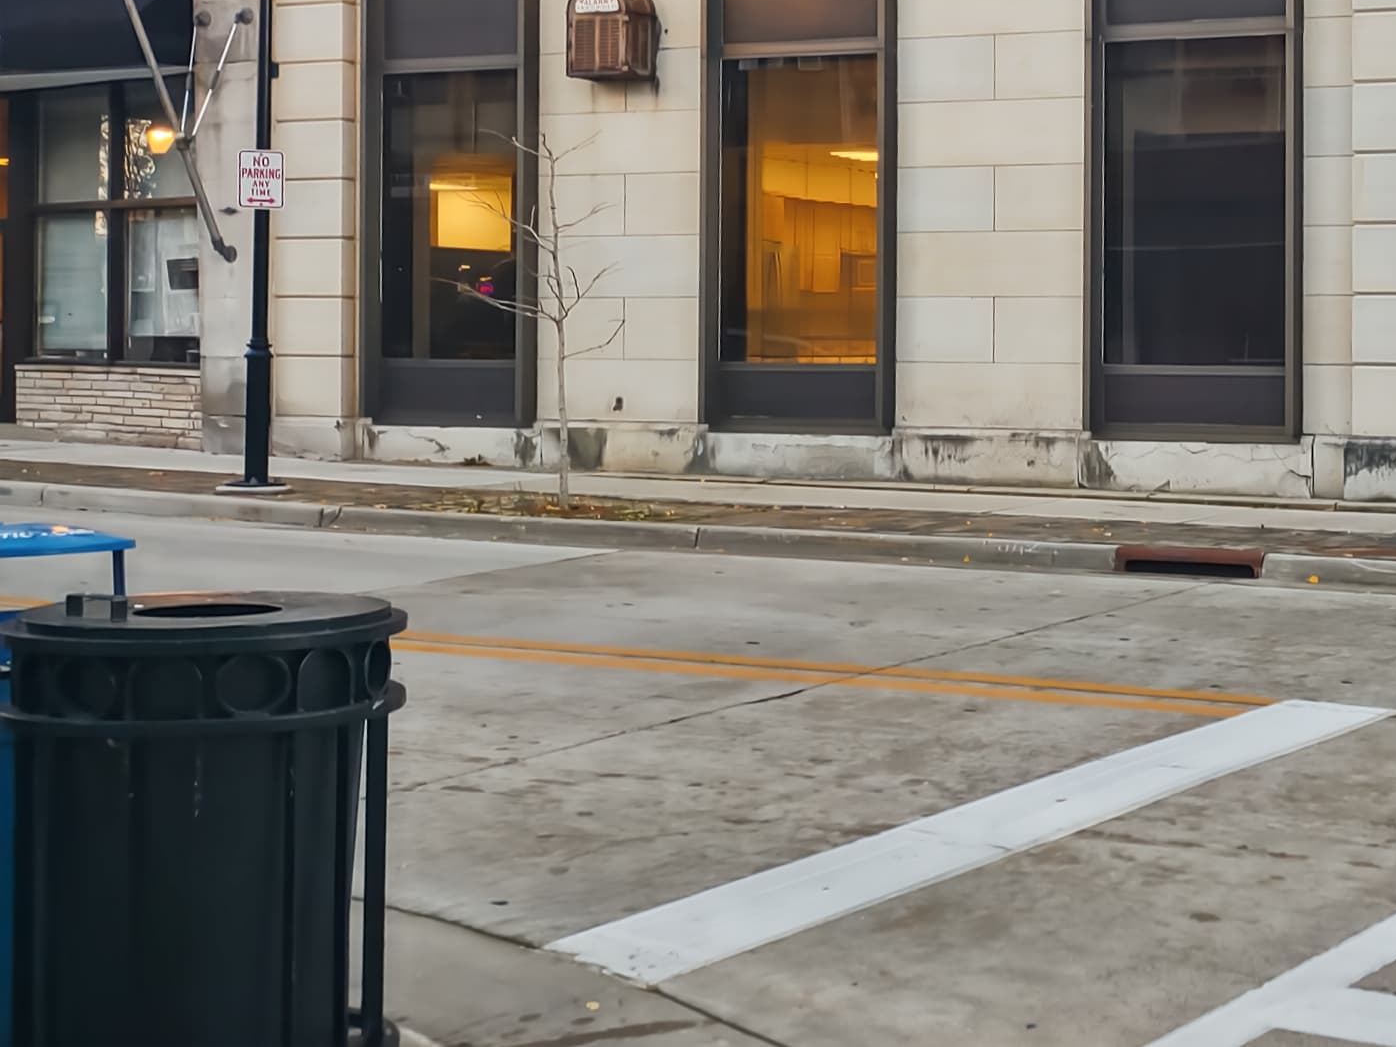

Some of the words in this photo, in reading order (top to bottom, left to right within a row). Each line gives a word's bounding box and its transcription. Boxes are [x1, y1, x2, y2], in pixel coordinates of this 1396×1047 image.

[253, 156, 270, 167] NO
[242, 168, 281, 179] PARKING
[252, 180, 270, 188] ANY
